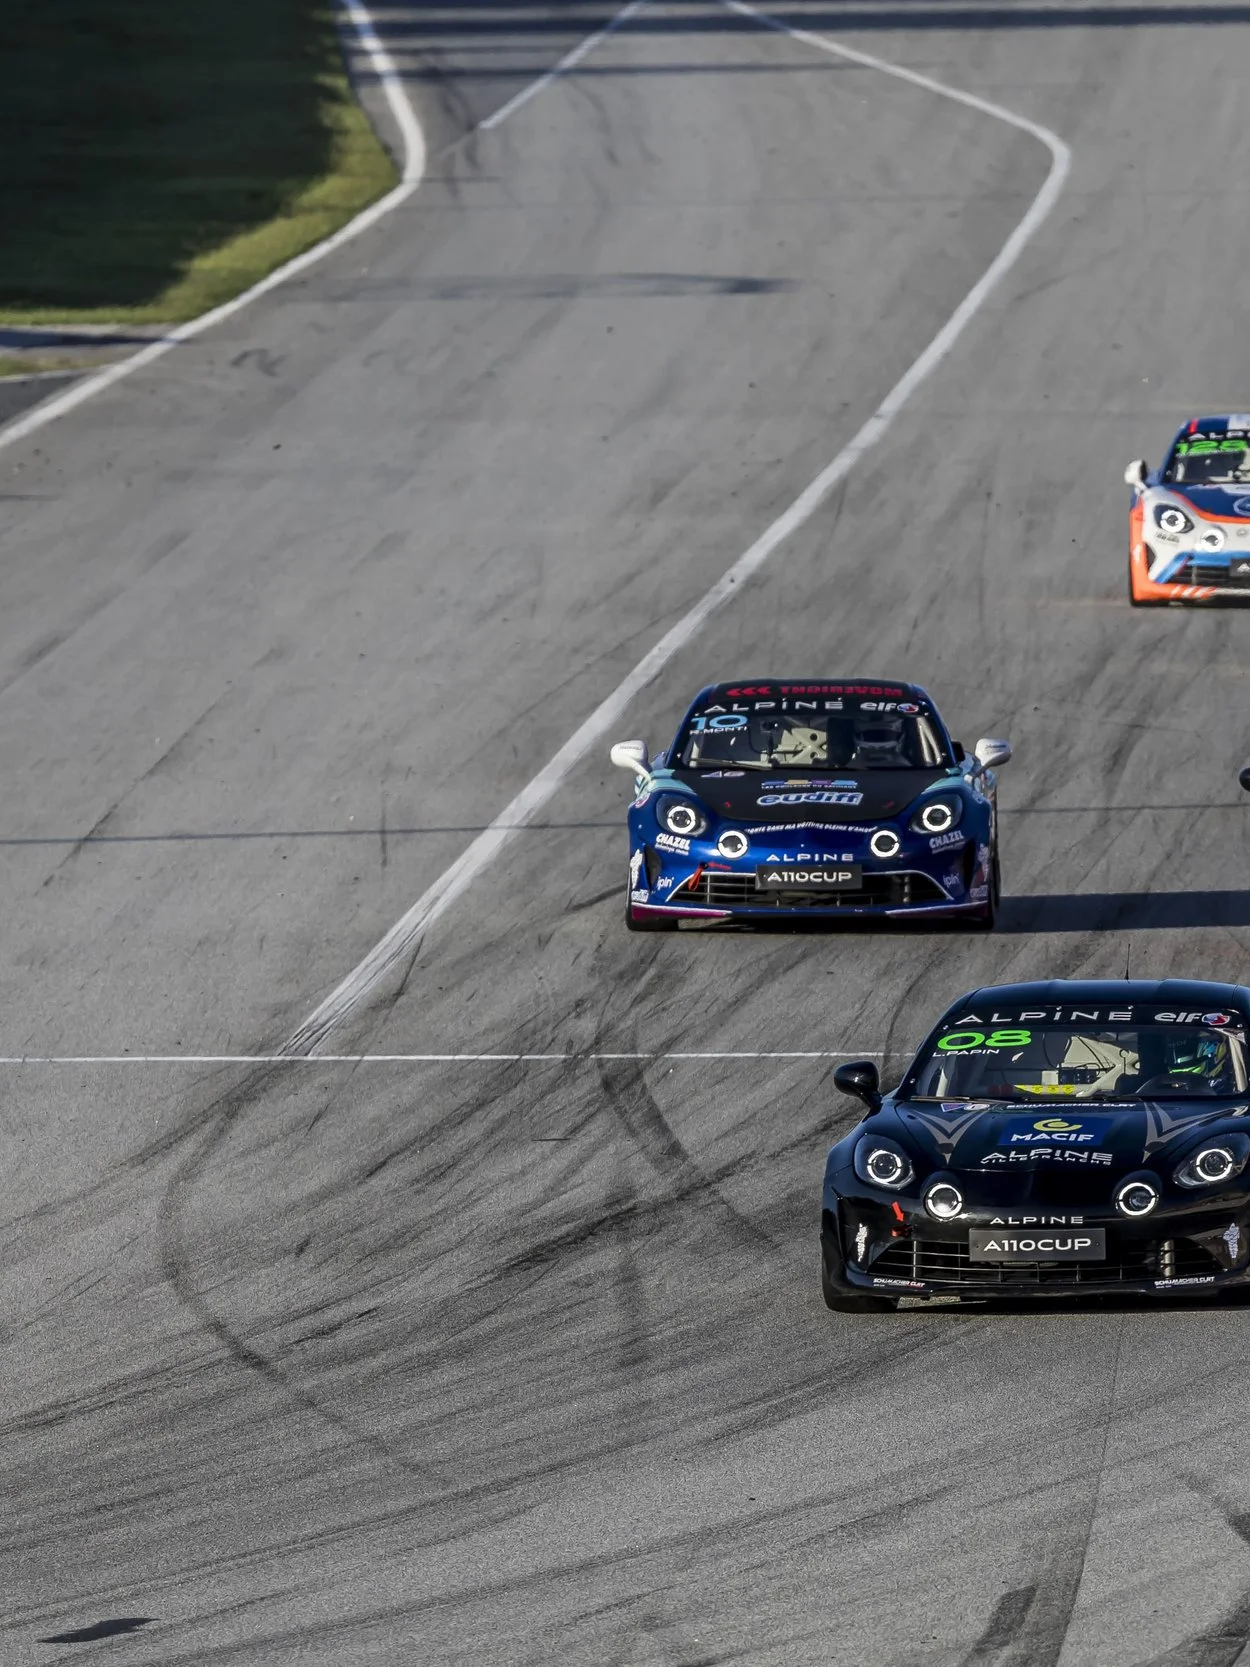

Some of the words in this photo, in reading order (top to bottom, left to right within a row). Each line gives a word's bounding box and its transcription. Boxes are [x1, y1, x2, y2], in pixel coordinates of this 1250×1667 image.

[704, 700, 844, 713] ALPINE
[860, 702, 898, 712] elf
[690, 714, 748, 731] 10
[758, 791, 863, 806] eudiff
[656, 833, 690, 850] CHAZEL
[929, 830, 964, 848] CHAZEL
[766, 853, 854, 862] ALPINE
[767, 871, 852, 883] A110CUP
[955, 1011, 1132, 1025] ALPINE
[1154, 1012, 1202, 1023] elf
[937, 1030, 1032, 1050] 08
[932, 1049, 1000, 1058] L.PAPIN
[1010, 1133, 1094, 1142] MACIF
[980, 1154, 1112, 1166] VILLEFRANCHE
[981, 1148, 1113, 1162] ALPINE
[990, 1216, 1084, 1225] ALPINE
[984, 1238, 1092, 1252] A110CUP
